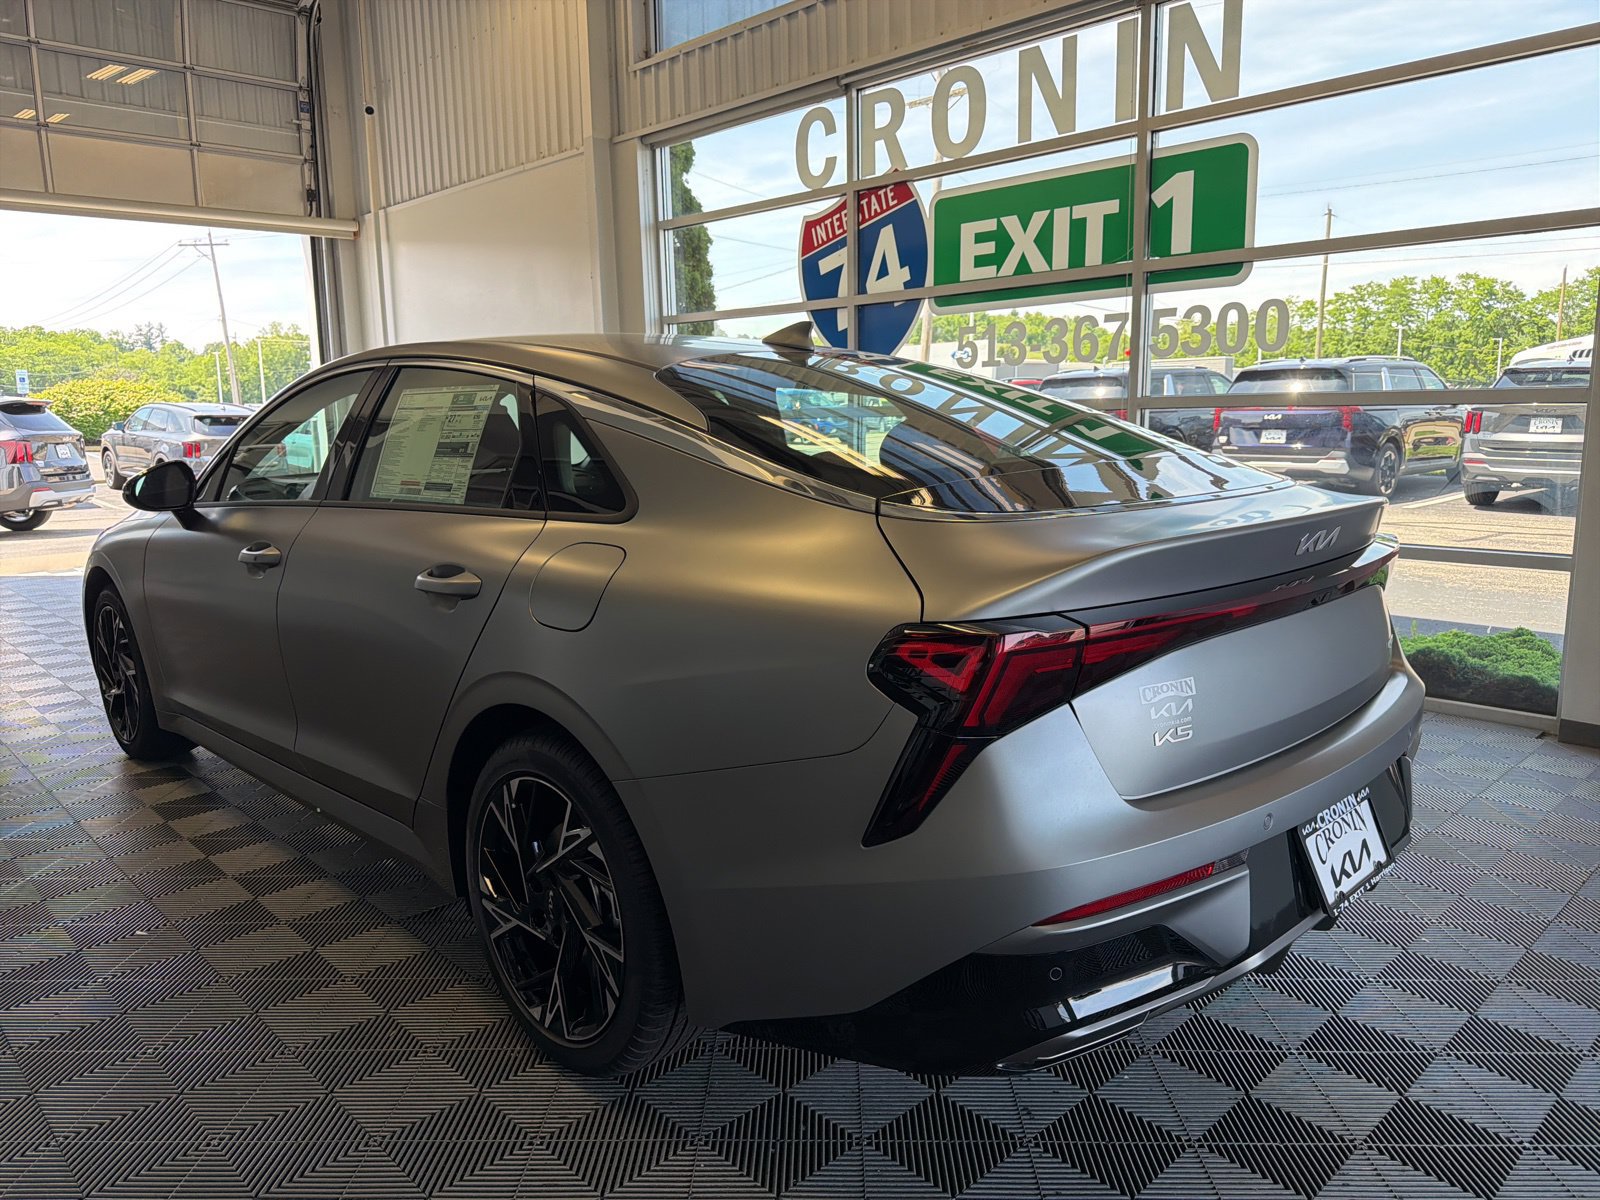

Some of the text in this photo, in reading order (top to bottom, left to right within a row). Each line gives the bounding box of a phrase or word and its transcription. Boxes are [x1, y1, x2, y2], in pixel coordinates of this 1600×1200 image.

[795, 0, 1243, 190] CRONIN
[811, 184, 898, 247] INTERTATE
[959, 169, 1195, 282] EXIT 1
[818, 223, 912, 332] 74
[955, 298, 1290, 370] 513-3675300
[1141, 679, 1194, 703] CRONIN
[1153, 724, 1193, 747] K5
[1314, 805, 1369, 866] CRONIN
[1316, 793, 1358, 829] CRONIN
[1333, 899, 1350, 917] I-74
[1349, 885, 1365, 904] EXIT
[1370, 862, 1397, 886] Harrison
